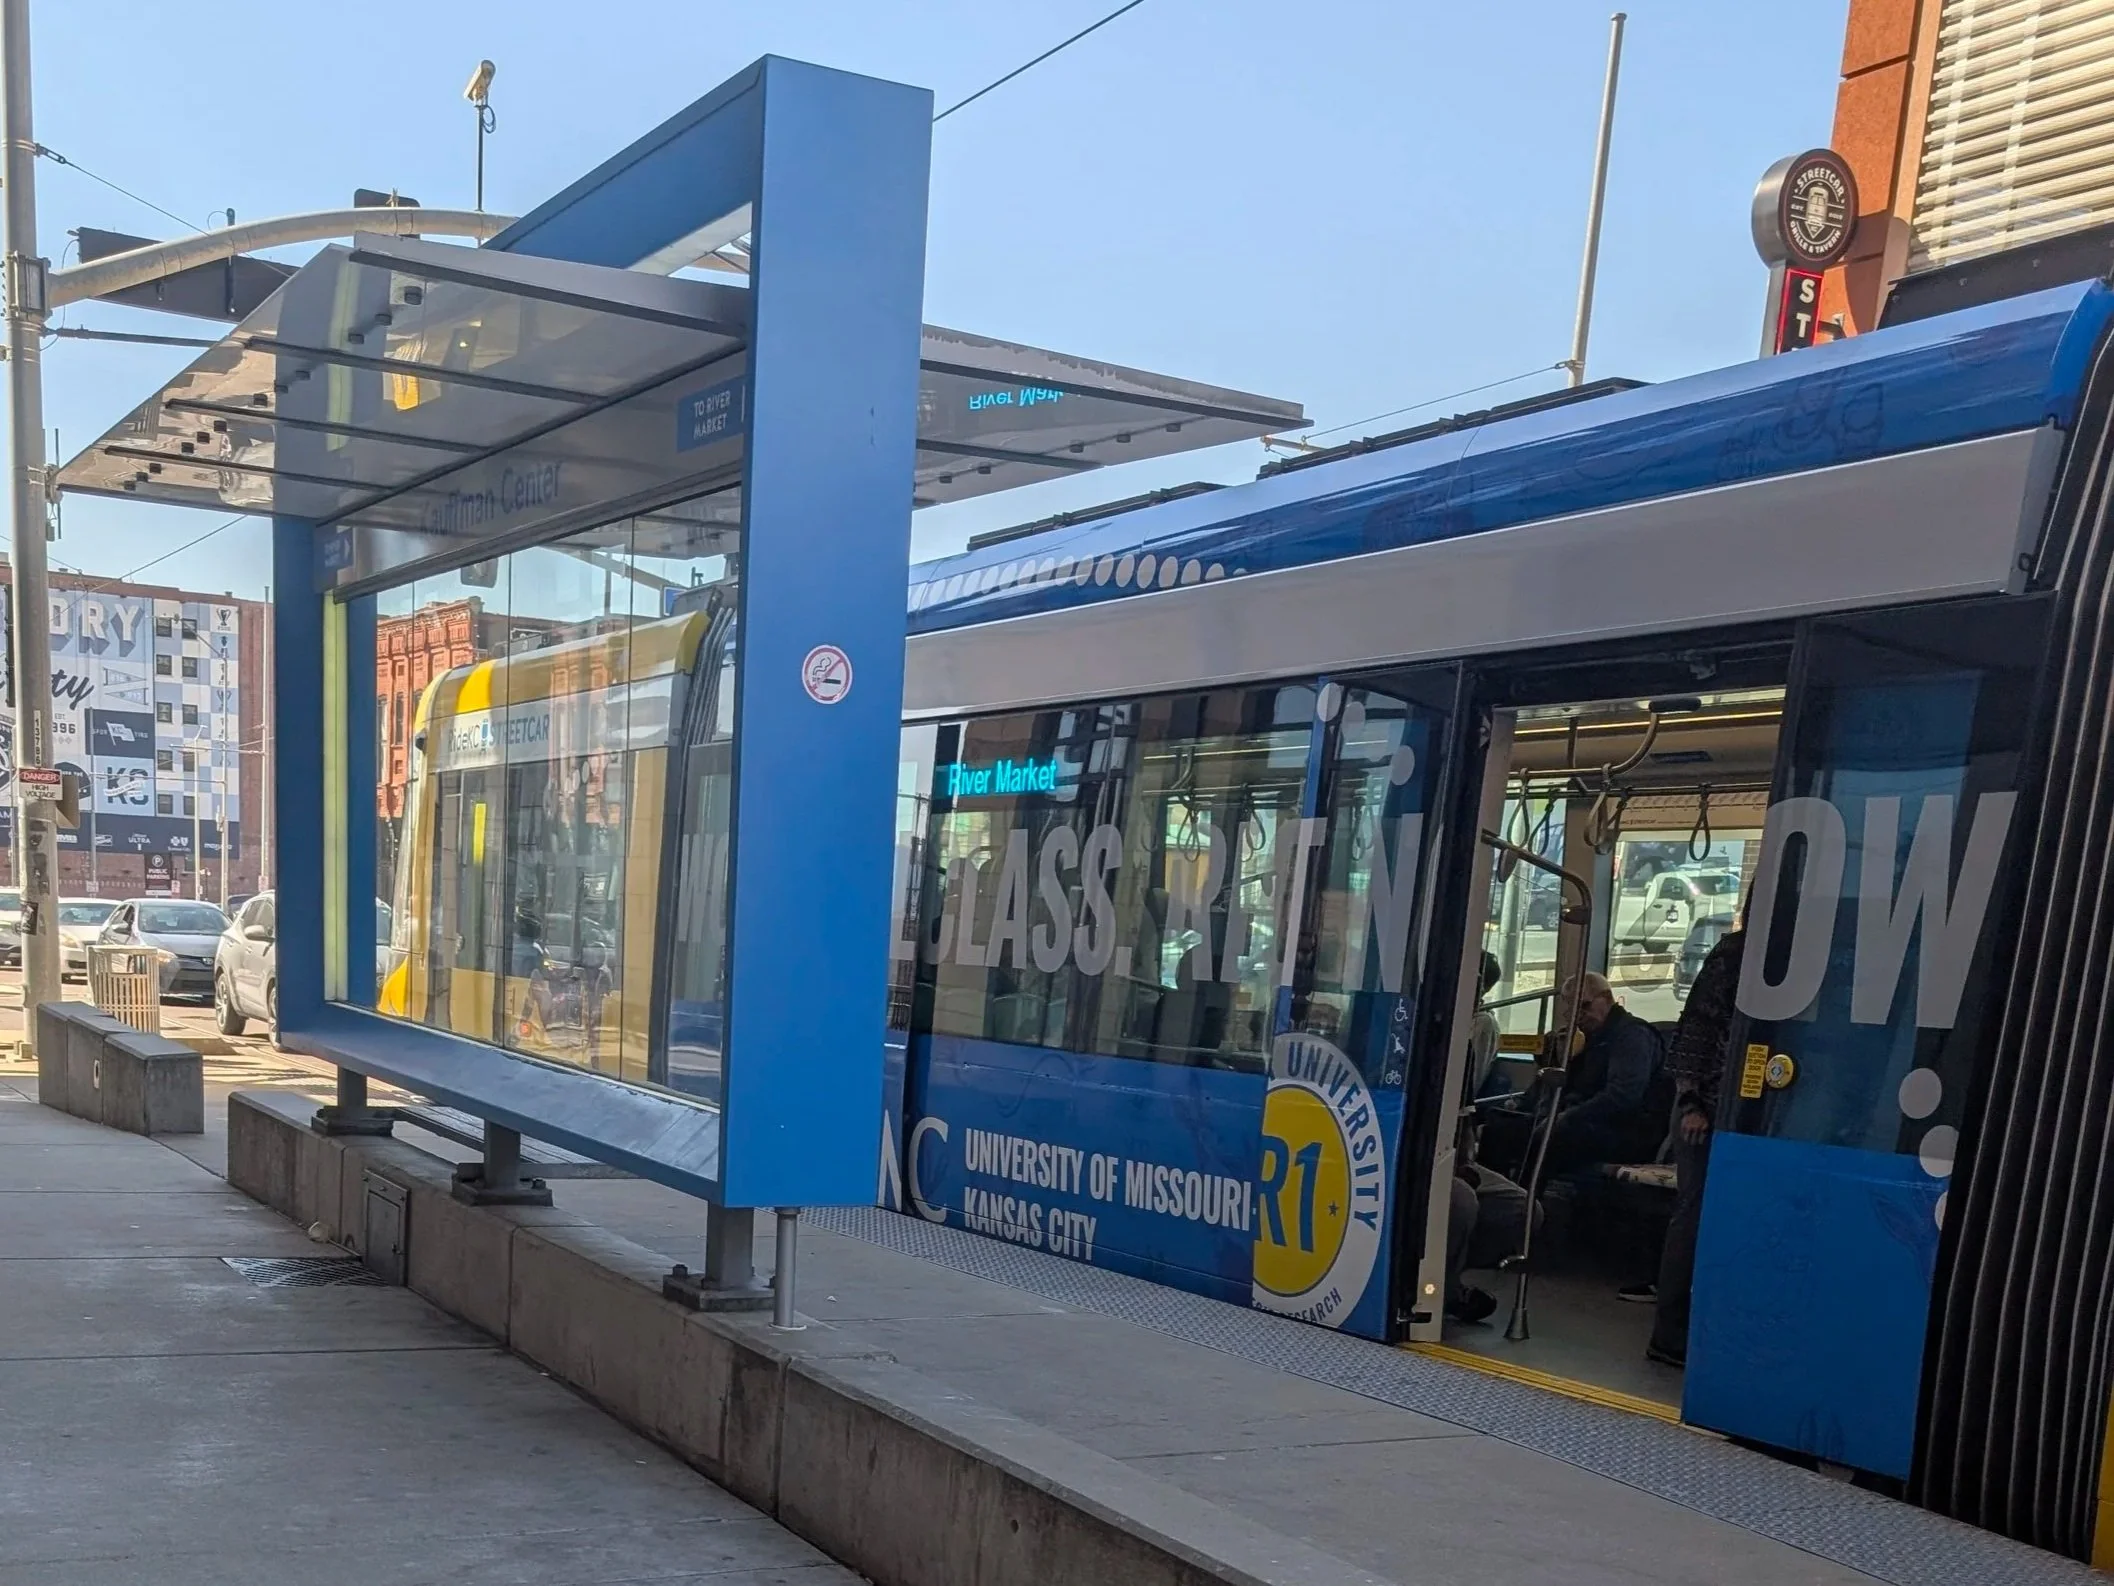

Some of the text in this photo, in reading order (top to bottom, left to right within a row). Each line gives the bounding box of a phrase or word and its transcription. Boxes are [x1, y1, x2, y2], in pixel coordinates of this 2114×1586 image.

[1796, 167, 1845, 197] STREETCAR
[1790, 220, 1841, 254] GRILLE & TAVERN
[693, 389, 731, 418] TO RIVER
[693, 413, 728, 440] MARKET
[501, 464, 561, 514] Center
[23, 772, 57, 780] DANGER
[948, 757, 1057, 795] River Market
[1287, 1040, 1380, 1232] UNIVERSITY
[965, 1127, 1085, 1195] UNIVERSITY
[1090, 1152, 1119, 1203] OF
[1253, 1134, 1323, 1253] R1
[964, 1186, 1098, 1262] KANSAS CITY
